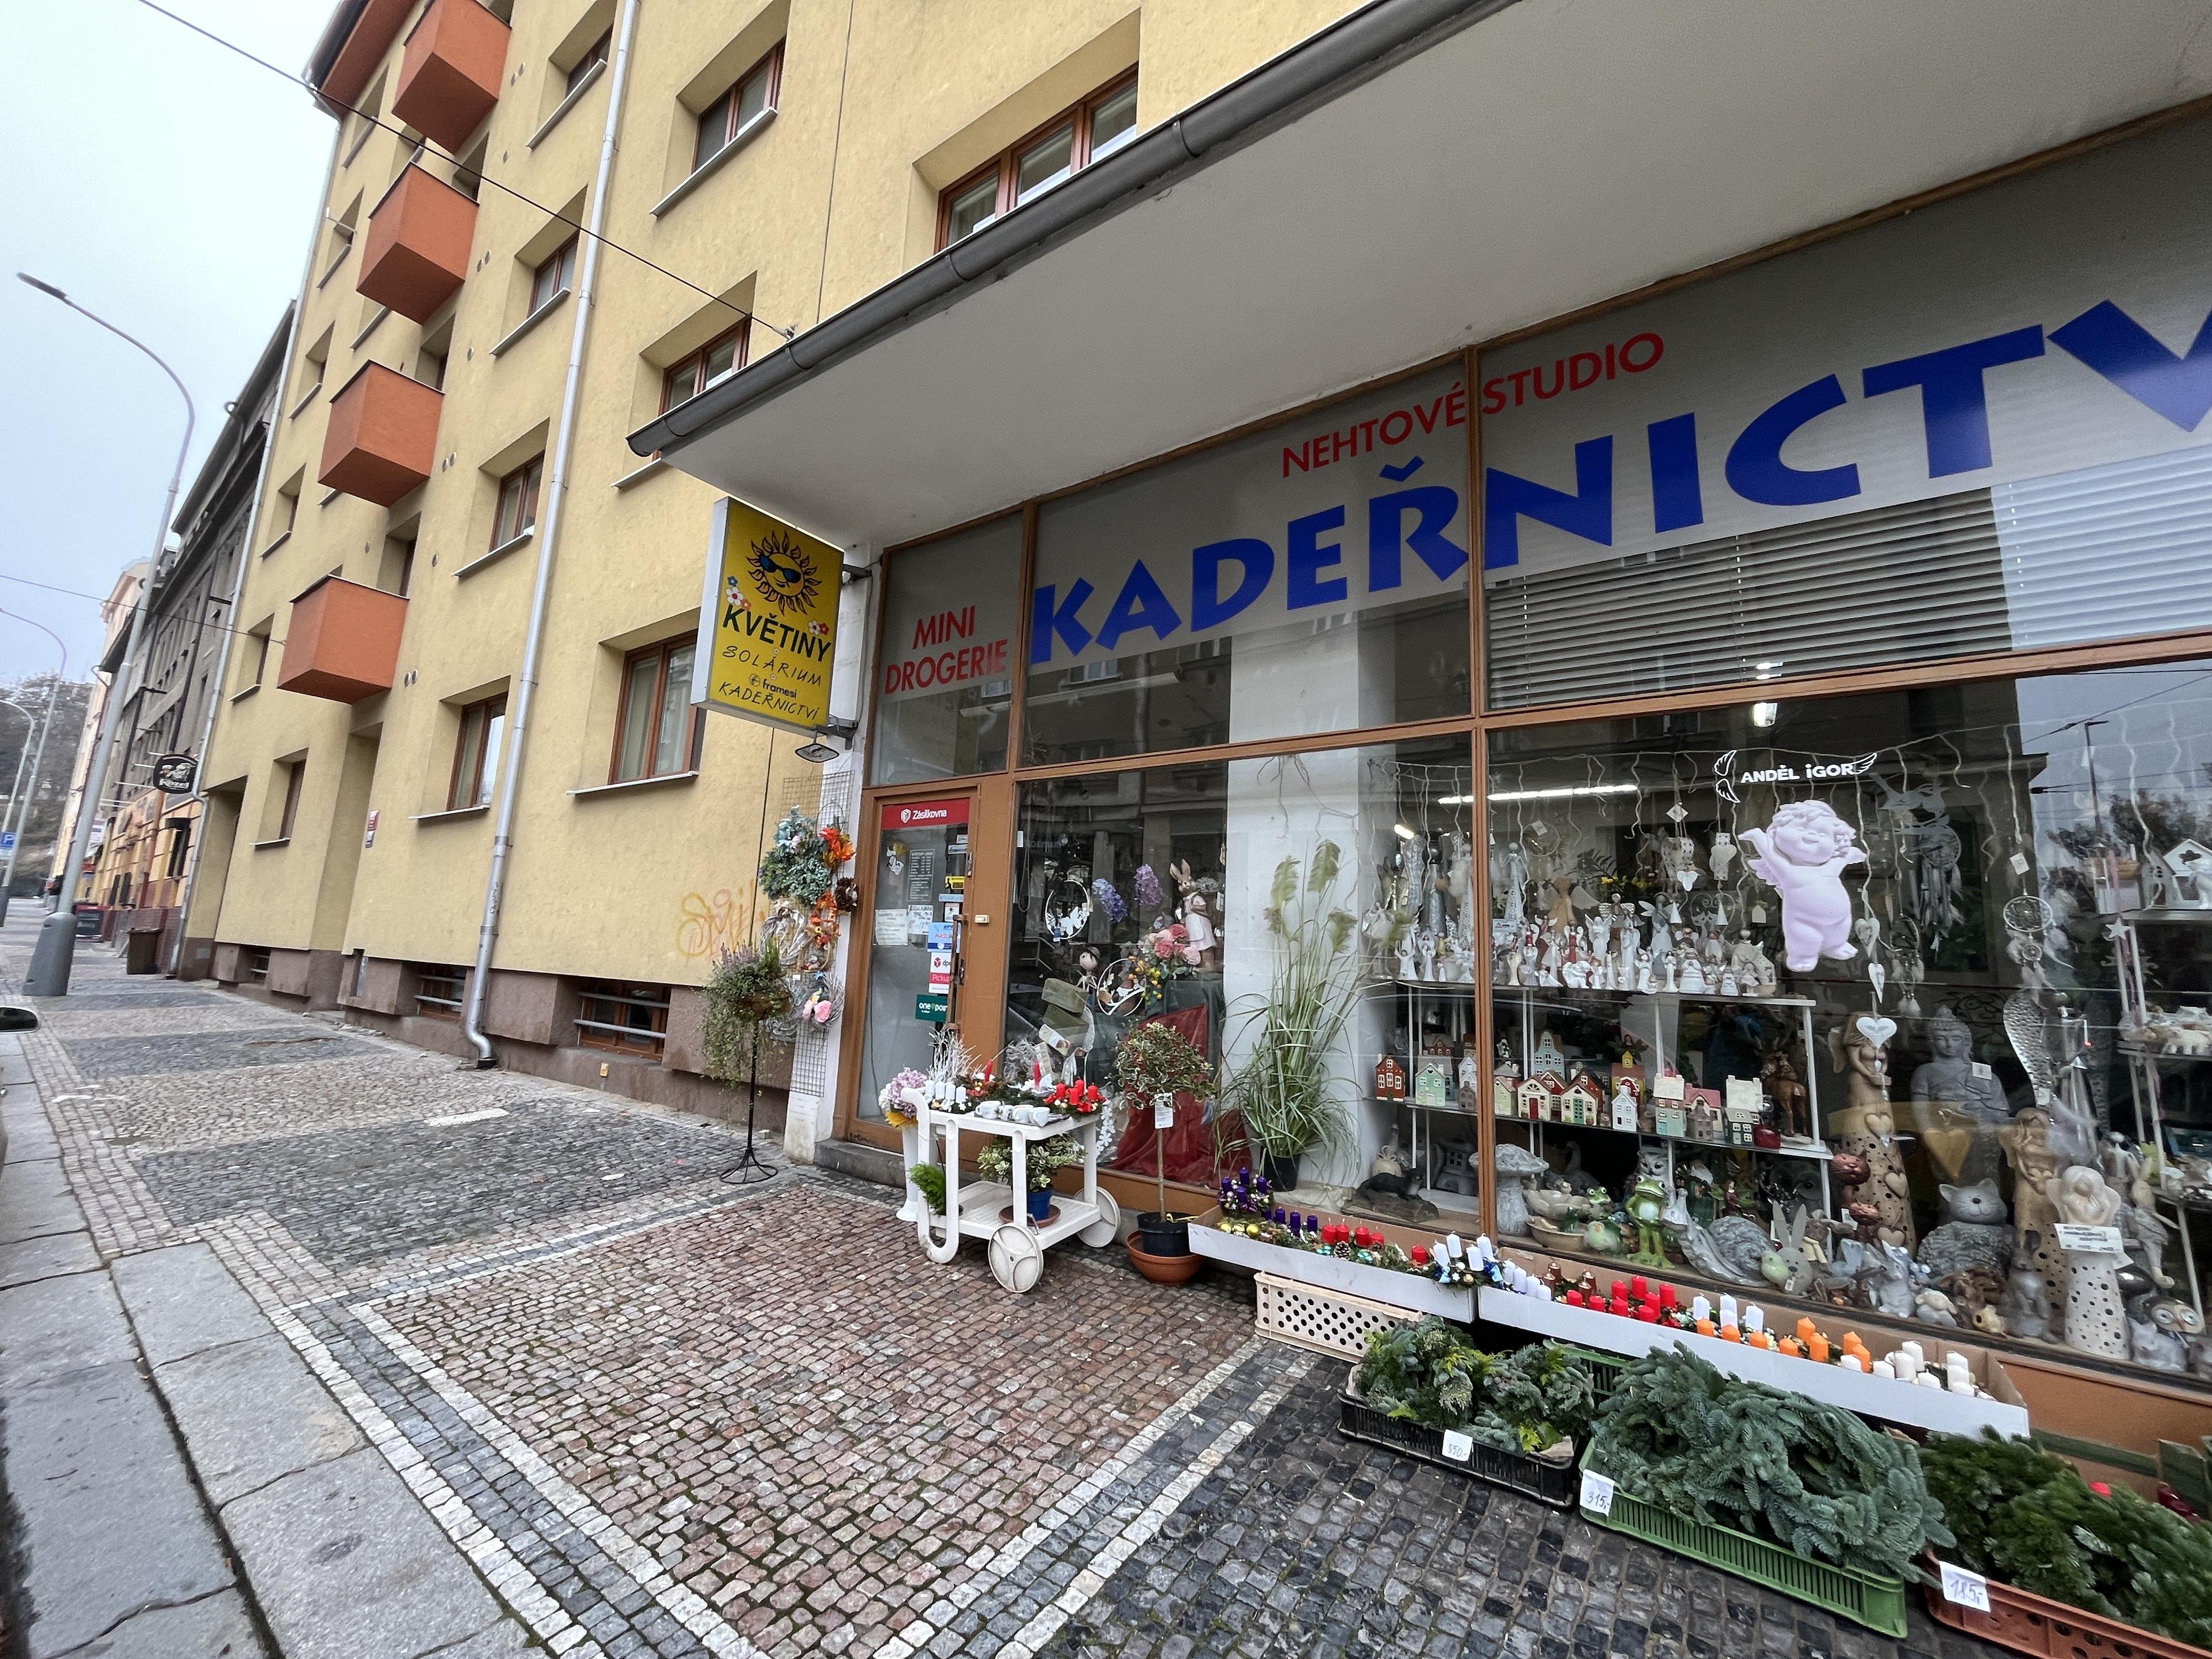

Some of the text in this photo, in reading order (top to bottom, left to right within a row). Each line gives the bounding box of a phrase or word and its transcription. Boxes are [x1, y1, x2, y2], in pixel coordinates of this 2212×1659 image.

[1282, 332, 1665, 478] NEHTOVÉ STUDIO
[722, 604, 832, 662] KVĚTINY
[912, 605, 975, 650] MINI
[722, 645, 822, 687] SOLÁRIUM
[885, 638, 1008, 695] DROGERIE
[718, 681, 821, 721] KADEŘNICTVÍ
[763, 678, 797, 699] framesi
[912, 808, 947, 820] Zásilkovna
[1585, 1491, 1610, 1510] 315,-
